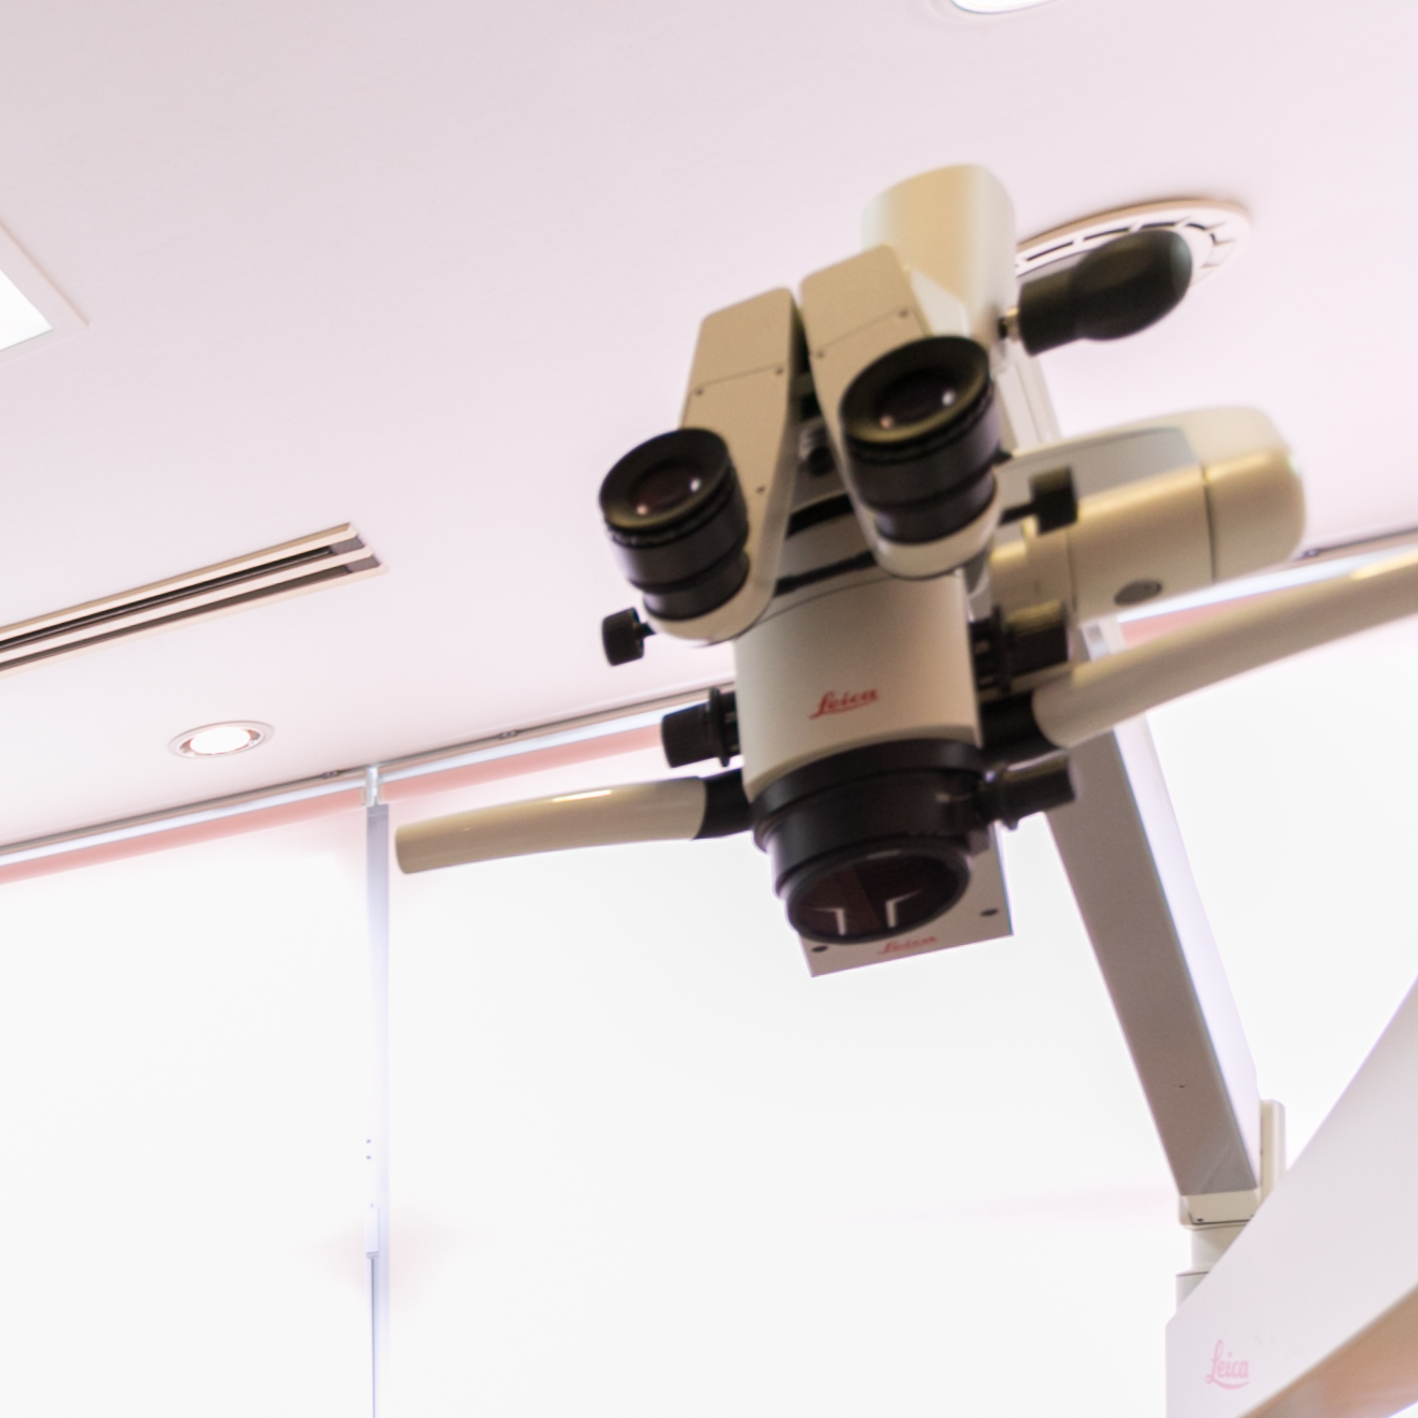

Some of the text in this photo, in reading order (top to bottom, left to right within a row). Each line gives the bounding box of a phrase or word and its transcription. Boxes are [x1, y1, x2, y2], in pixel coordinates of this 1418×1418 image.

[808, 689, 878, 720] Leica
[877, 936, 936, 956] Leica
[1205, 1339, 1249, 1390] Leica
